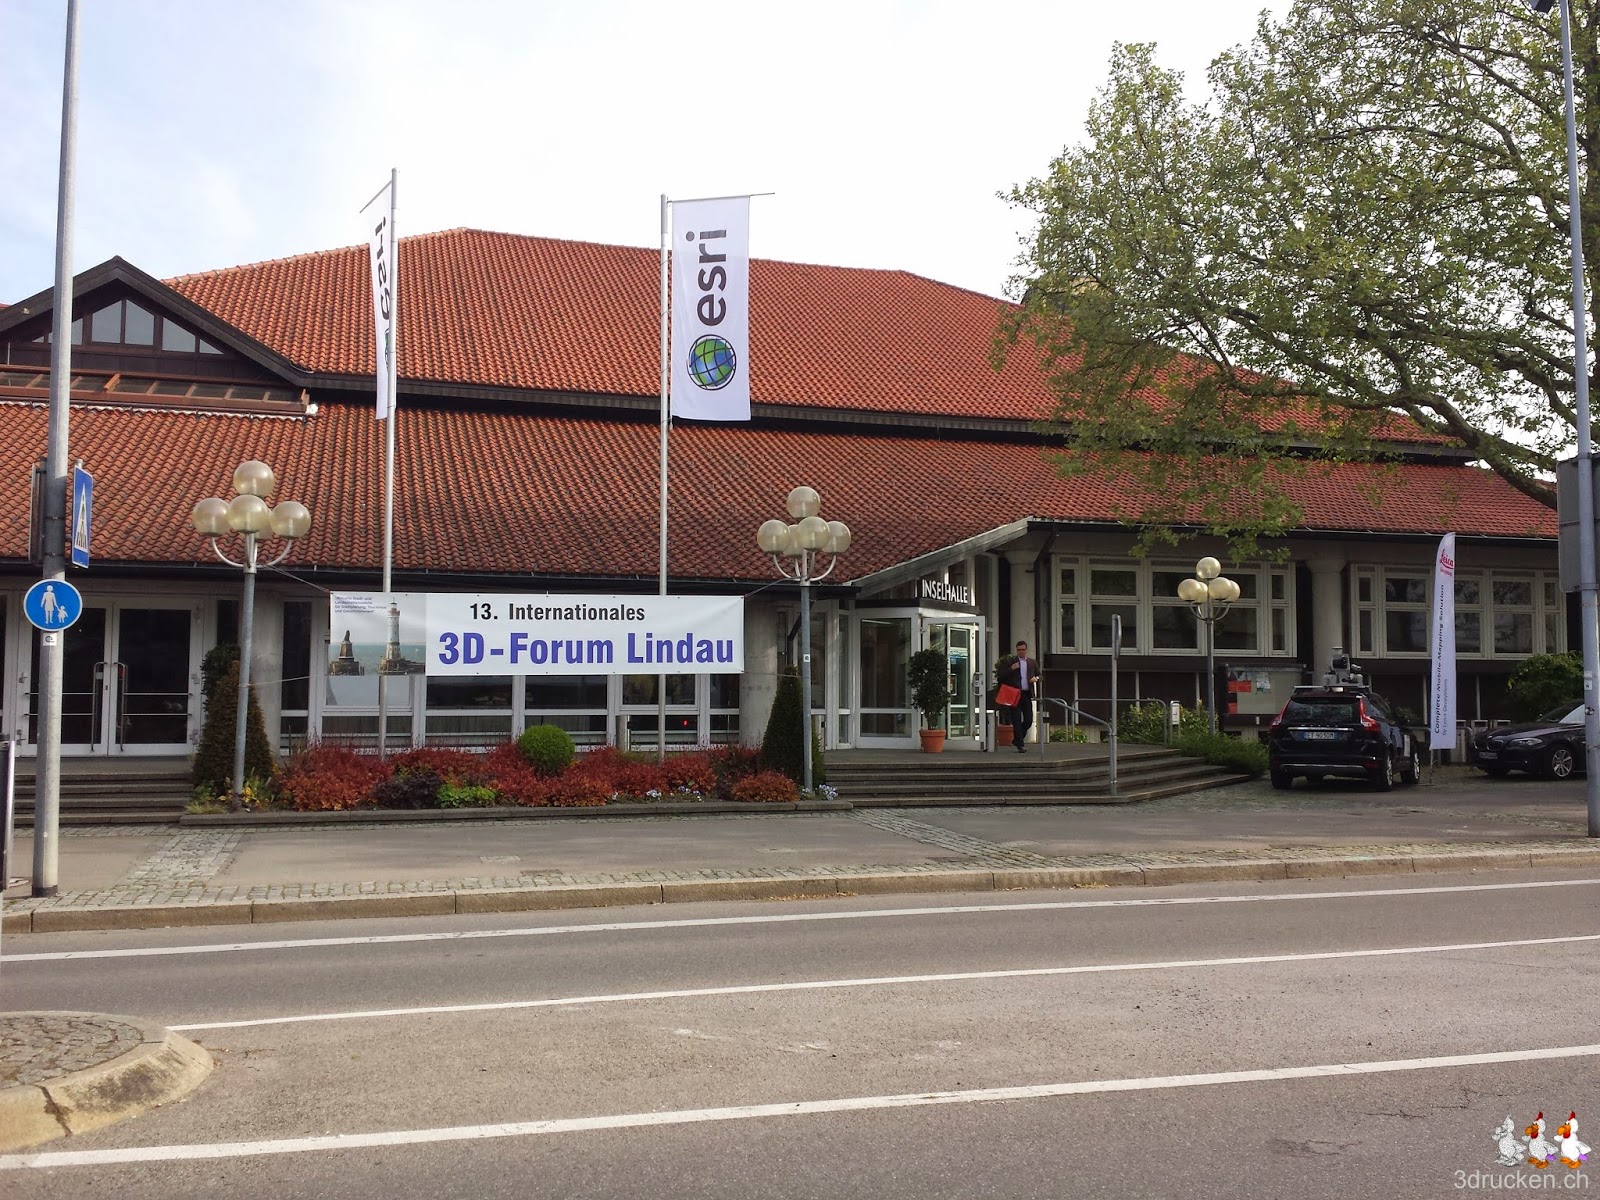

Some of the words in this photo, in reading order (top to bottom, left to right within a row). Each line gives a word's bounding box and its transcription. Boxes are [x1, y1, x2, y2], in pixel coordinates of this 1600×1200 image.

[685, 229, 727, 327] esri
[1440, 549, 1455, 569] Leica
[922, 579, 968, 604] INSELHALLE
[470, 603, 498, 620] 13.
[509, 603, 645, 621] Internationales
[627, 632, 733, 664] Lindau
